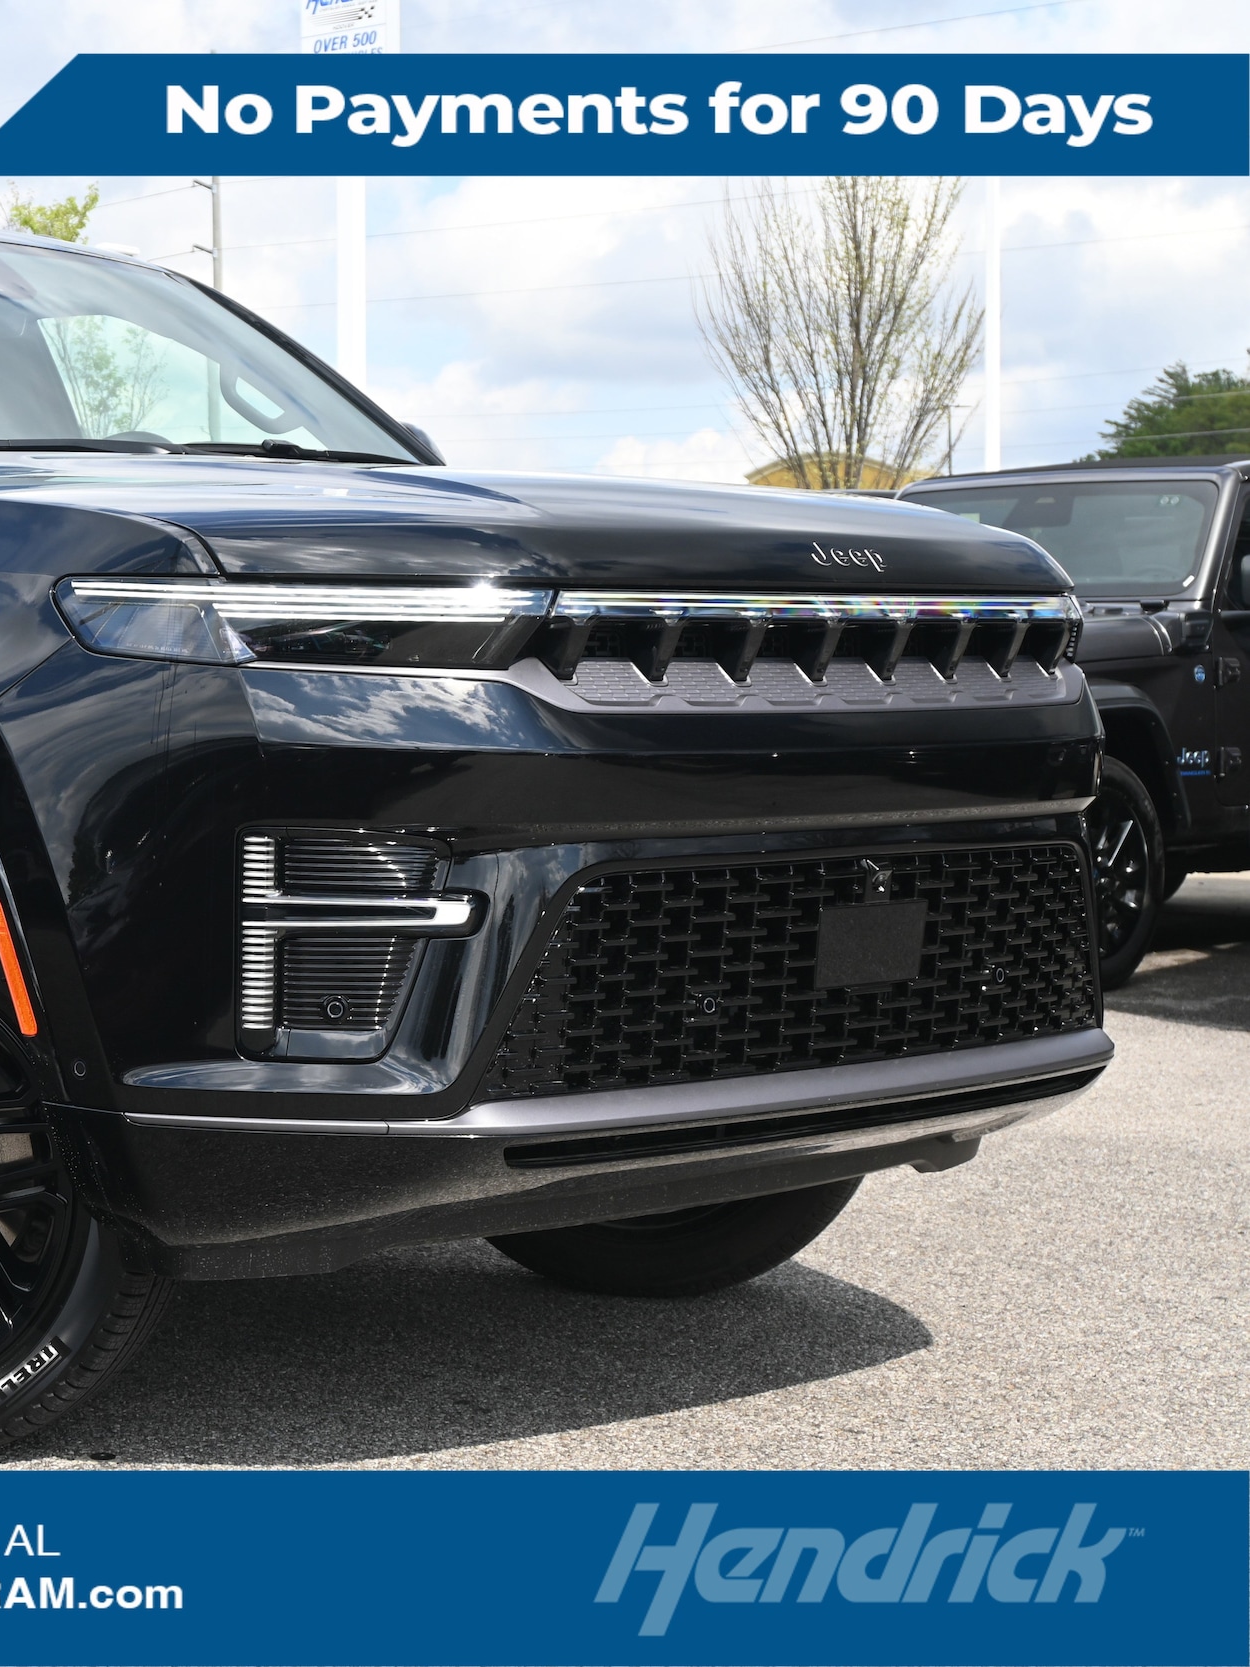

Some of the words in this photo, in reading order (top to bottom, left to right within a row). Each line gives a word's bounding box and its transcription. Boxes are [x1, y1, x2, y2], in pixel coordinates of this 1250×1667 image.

[313, 35, 348, 54] OVER
[352, 30, 377, 48] 500
[811, 541, 888, 573] Jeep
[1176, 746, 1210, 768] Jeep
